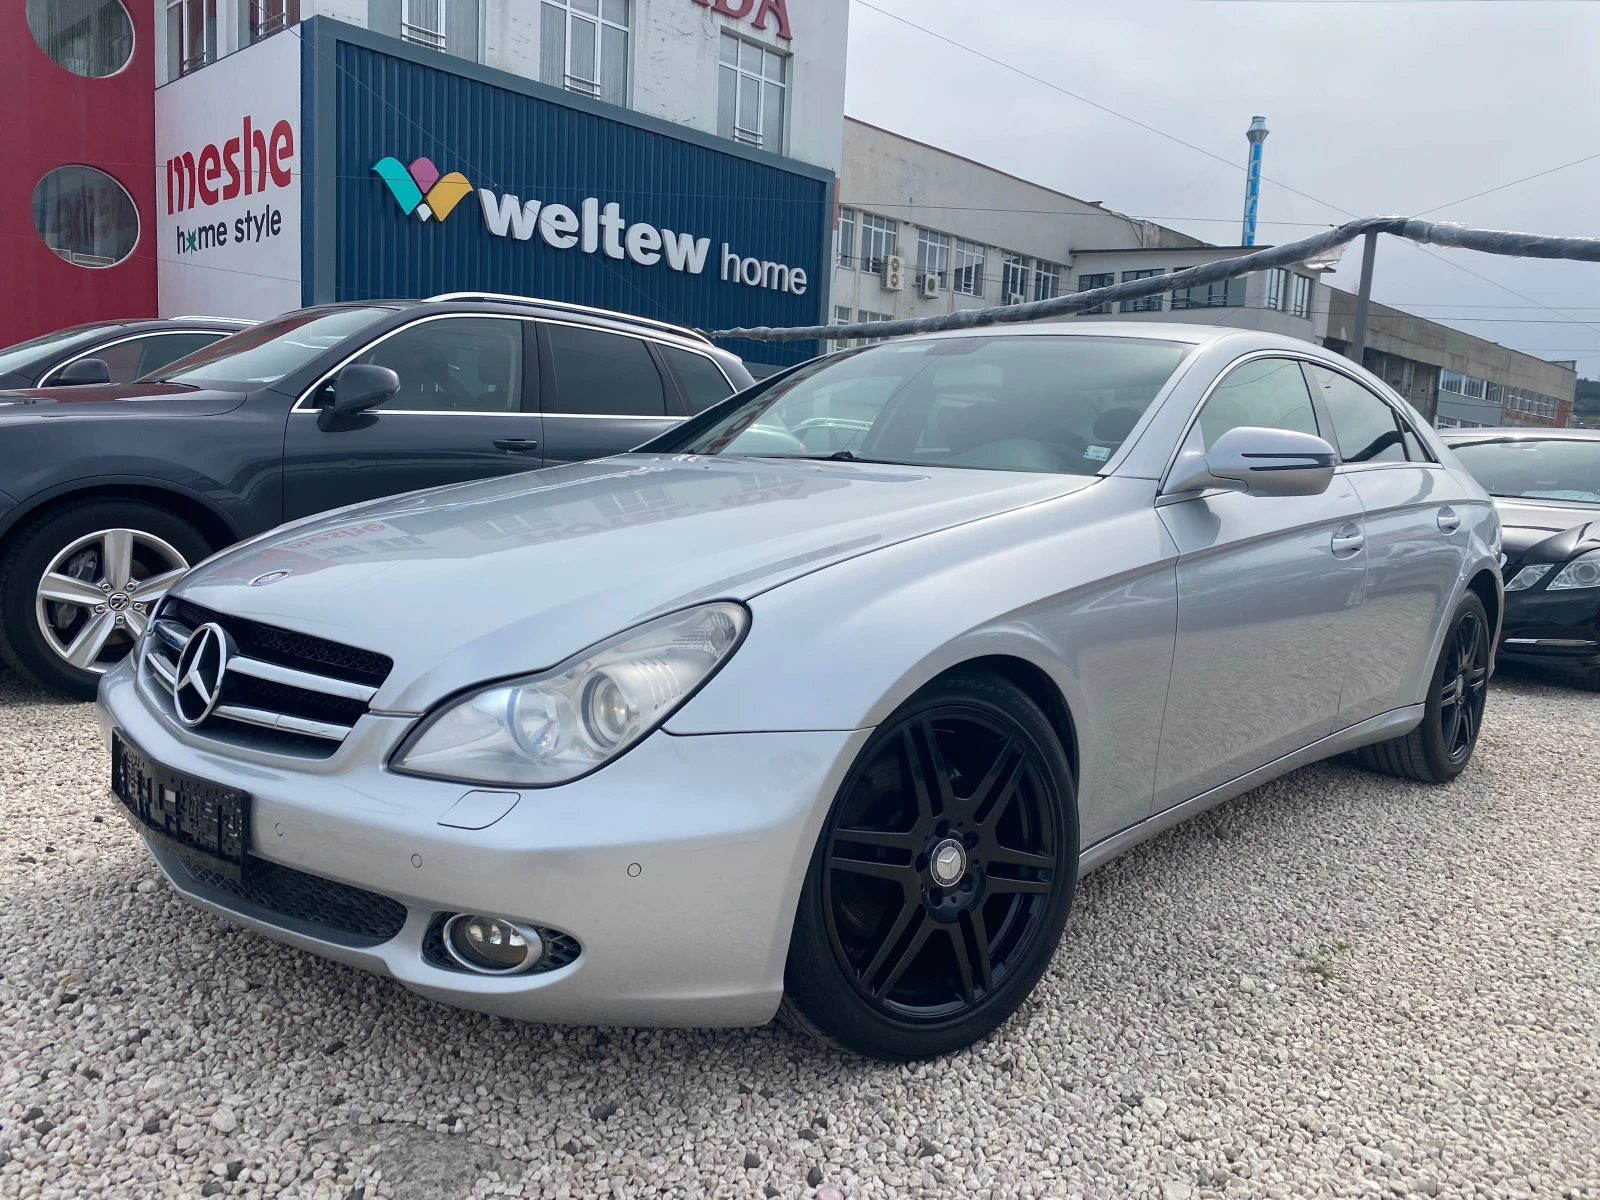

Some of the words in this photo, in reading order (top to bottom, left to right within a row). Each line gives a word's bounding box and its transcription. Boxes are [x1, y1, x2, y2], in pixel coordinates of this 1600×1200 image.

[167, 115, 294, 215] meshe
[234, 204, 282, 244] style
[478, 188, 710, 274] weltew
[721, 242, 807, 295] home
